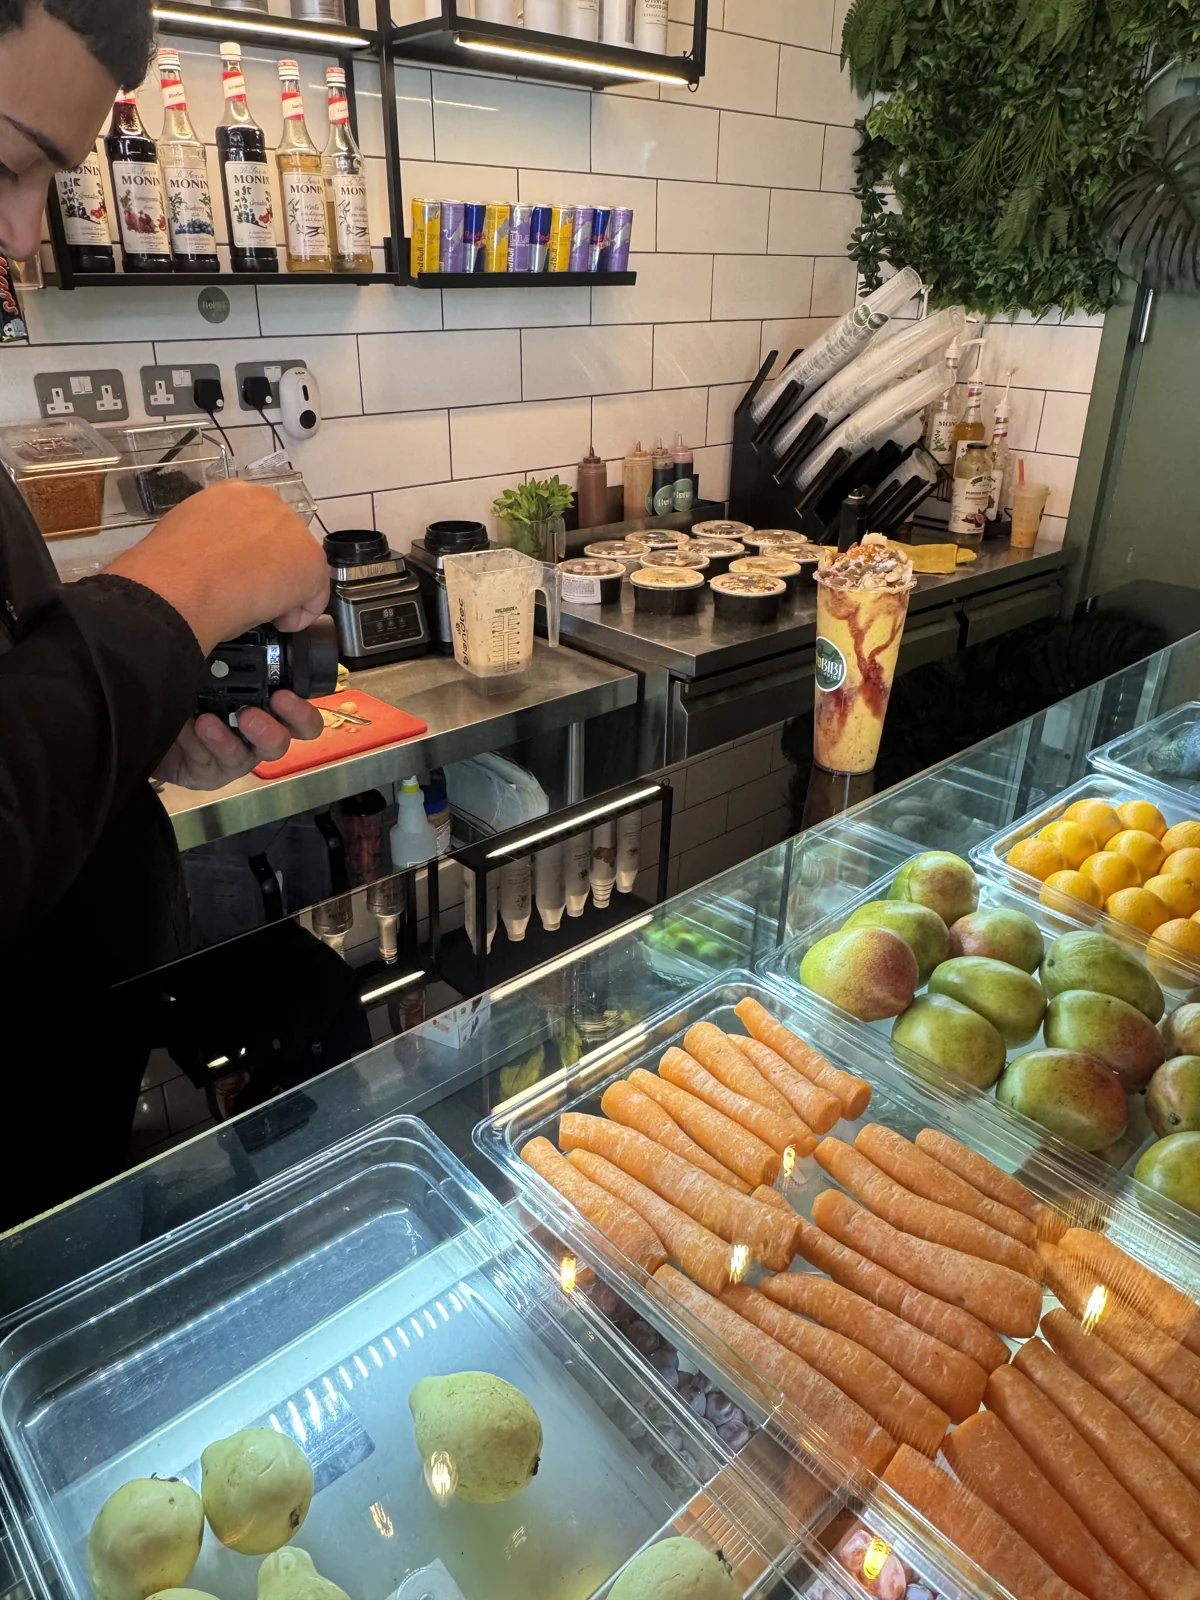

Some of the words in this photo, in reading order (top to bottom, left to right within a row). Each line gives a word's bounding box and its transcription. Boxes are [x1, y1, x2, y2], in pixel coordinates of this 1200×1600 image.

[170, 179, 209, 189] MONIN
[234, 175, 270, 184] MONIN
[458, 597, 469, 666] blendtec
